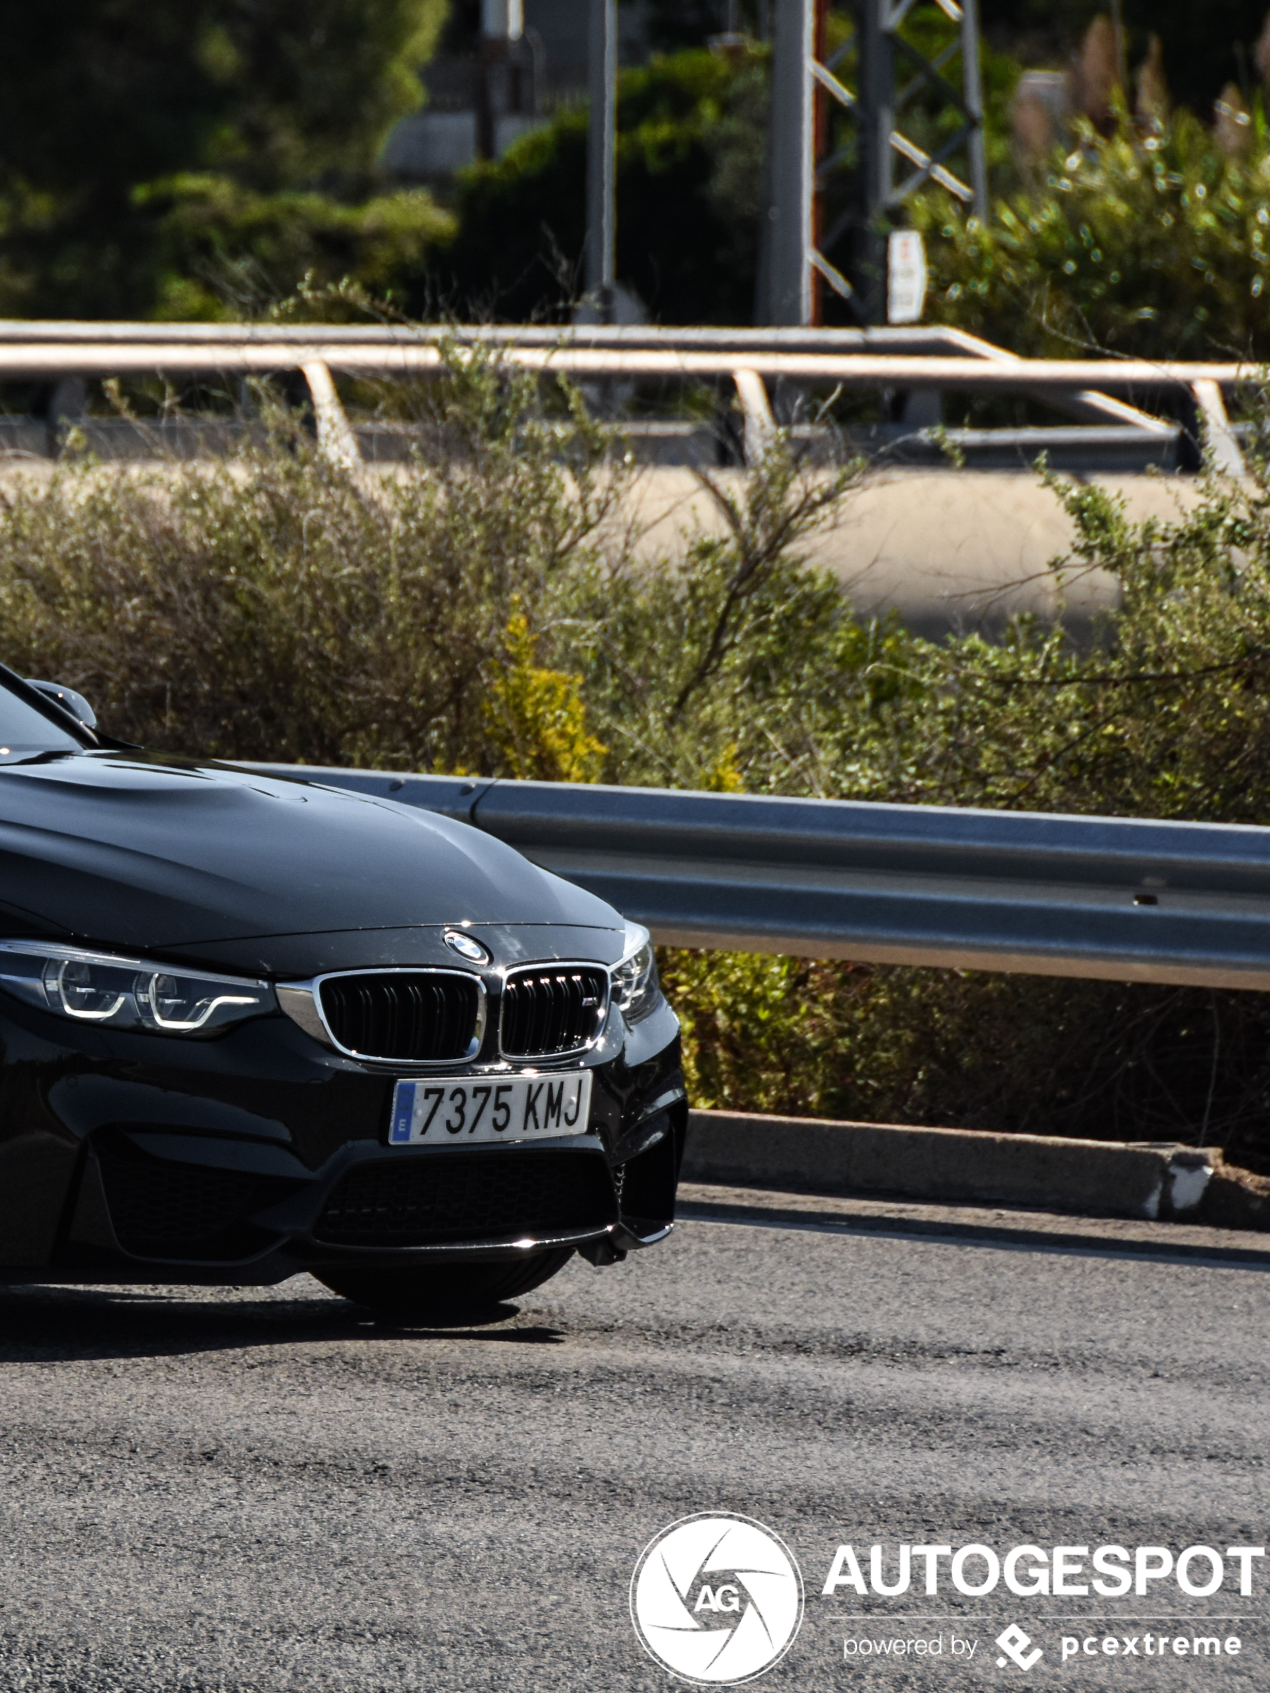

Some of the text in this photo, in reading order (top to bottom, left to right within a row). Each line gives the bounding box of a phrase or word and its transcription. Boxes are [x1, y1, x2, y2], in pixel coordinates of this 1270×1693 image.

[420, 1086, 513, 1135] 7375
[523, 1079, 583, 1131] KMJ
[398, 1118, 407, 1132] E
